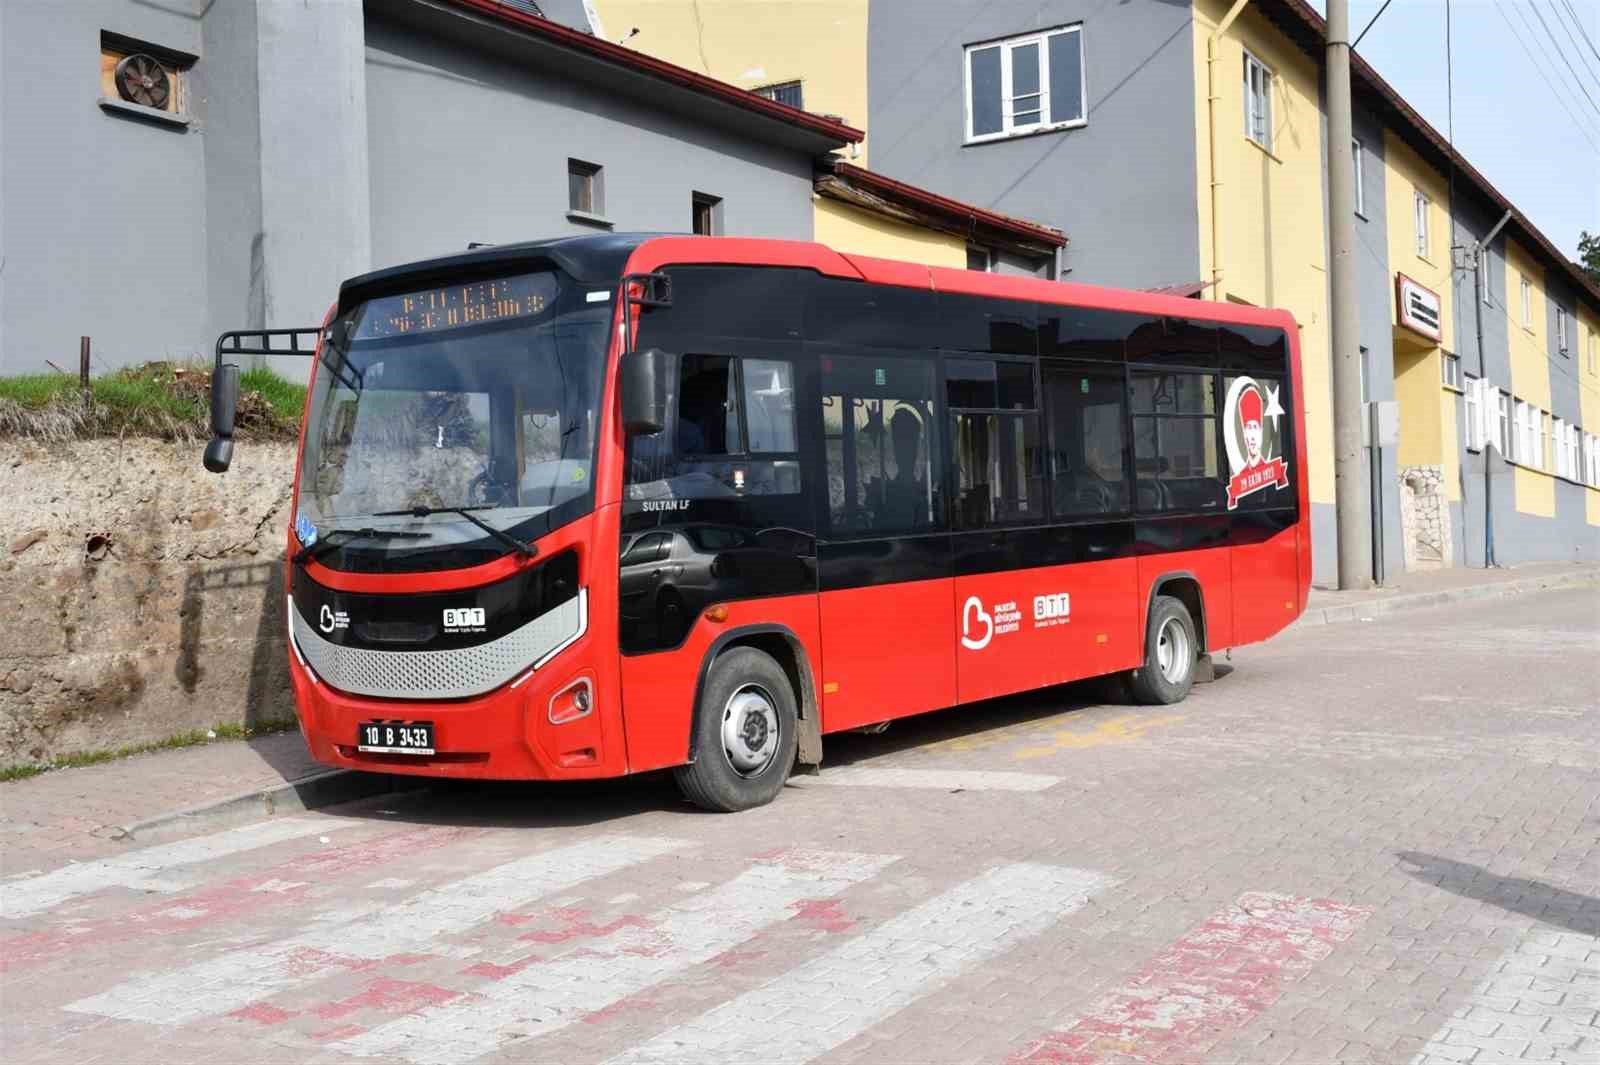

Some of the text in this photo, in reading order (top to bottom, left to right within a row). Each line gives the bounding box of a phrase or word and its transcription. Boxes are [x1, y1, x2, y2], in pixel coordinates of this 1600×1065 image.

[642, 500, 690, 512] SULTAN LF
[1035, 596, 1068, 617] BTT
[446, 610, 482, 624] BTT
[366, 727, 427, 747] 10 B 3433
